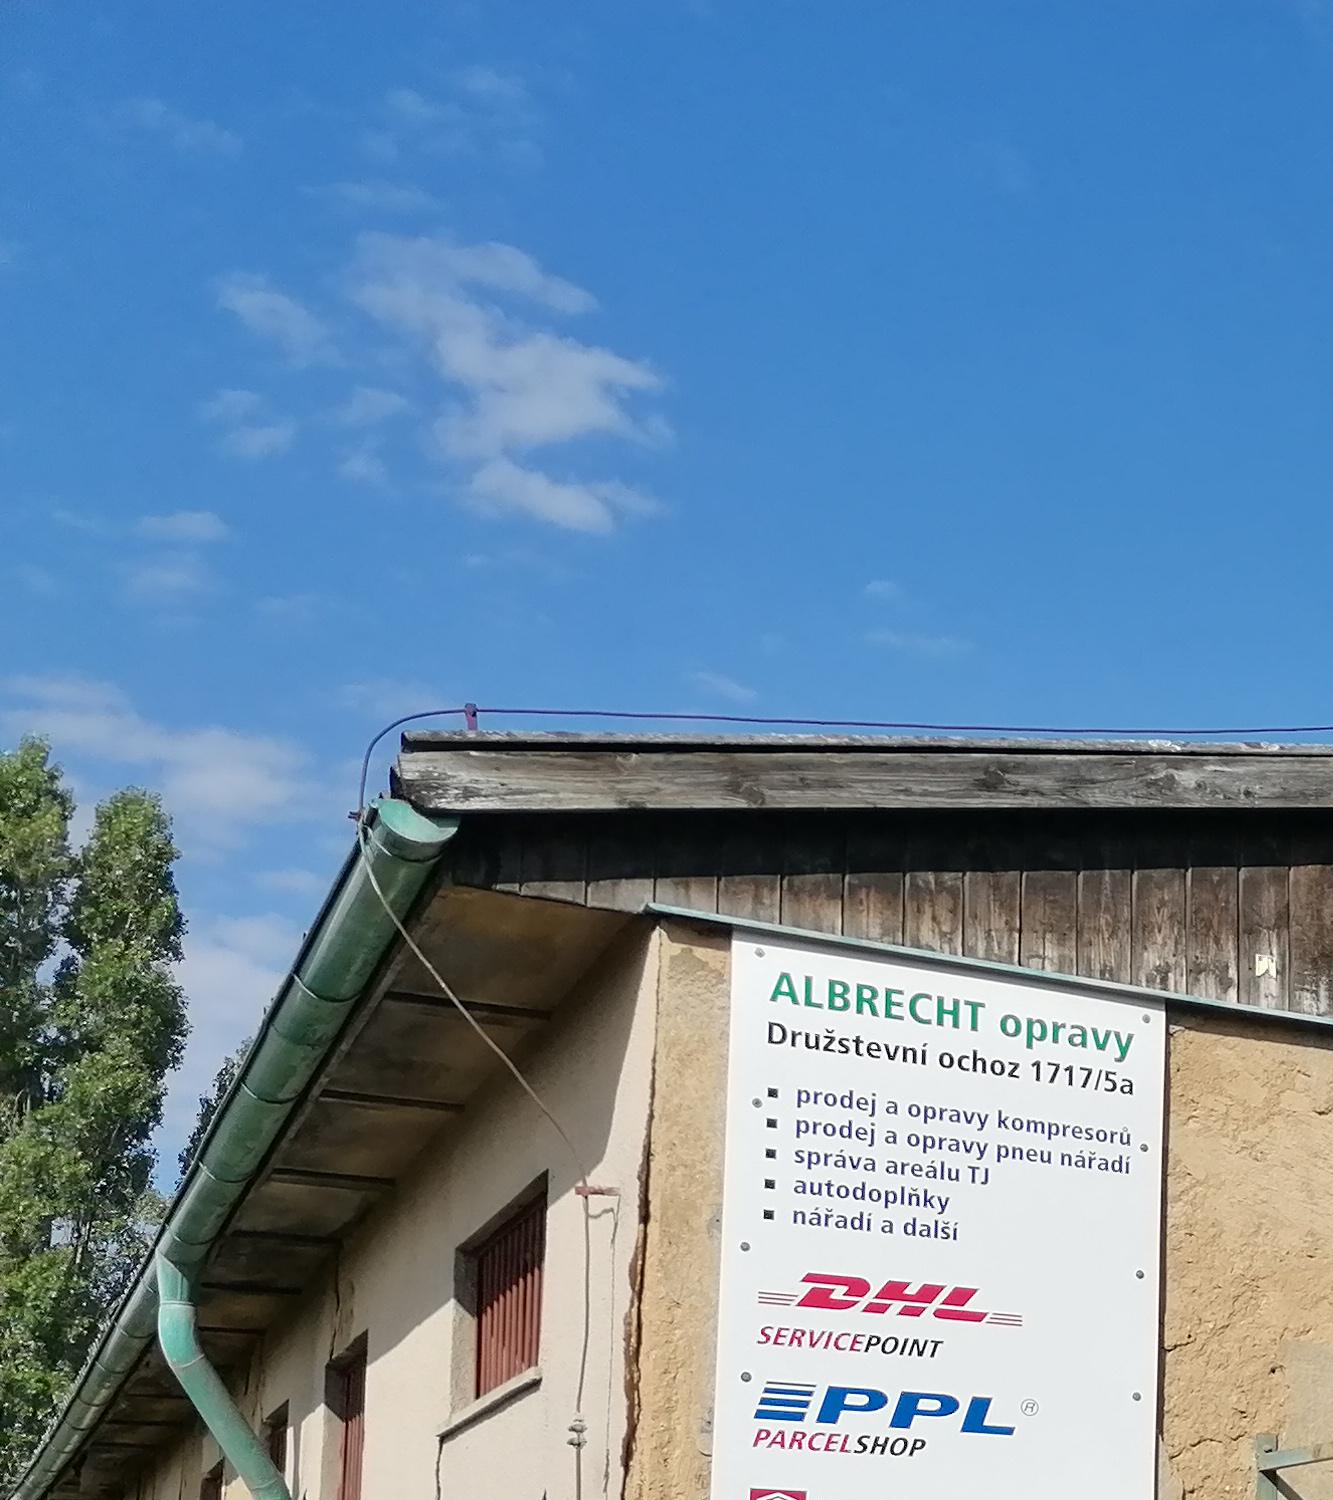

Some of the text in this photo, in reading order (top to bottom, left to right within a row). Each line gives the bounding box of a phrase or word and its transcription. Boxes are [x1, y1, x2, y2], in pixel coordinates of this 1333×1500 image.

[769, 971, 1135, 1062] ALBRECHT opravy
[767, 1021, 1135, 1096] Družstevní ochoz 1717/5a
[796, 1085, 1132, 1148] prodej a opravy kompresorů
[793, 1147, 991, 1187] správa areálu TJ
[795, 1115, 1132, 1176] prodej a opravy pneu nářadí
[793, 1177, 951, 1216] autodoplňky
[792, 1207, 960, 1242] nářadí a další
[796, 1273, 989, 1324] DHL
[756, 1325, 945, 1359] SERVICEPOINT
[815, 1385, 1017, 1436] PPL
[752, 1428, 928, 1458] PARCELSHOP
